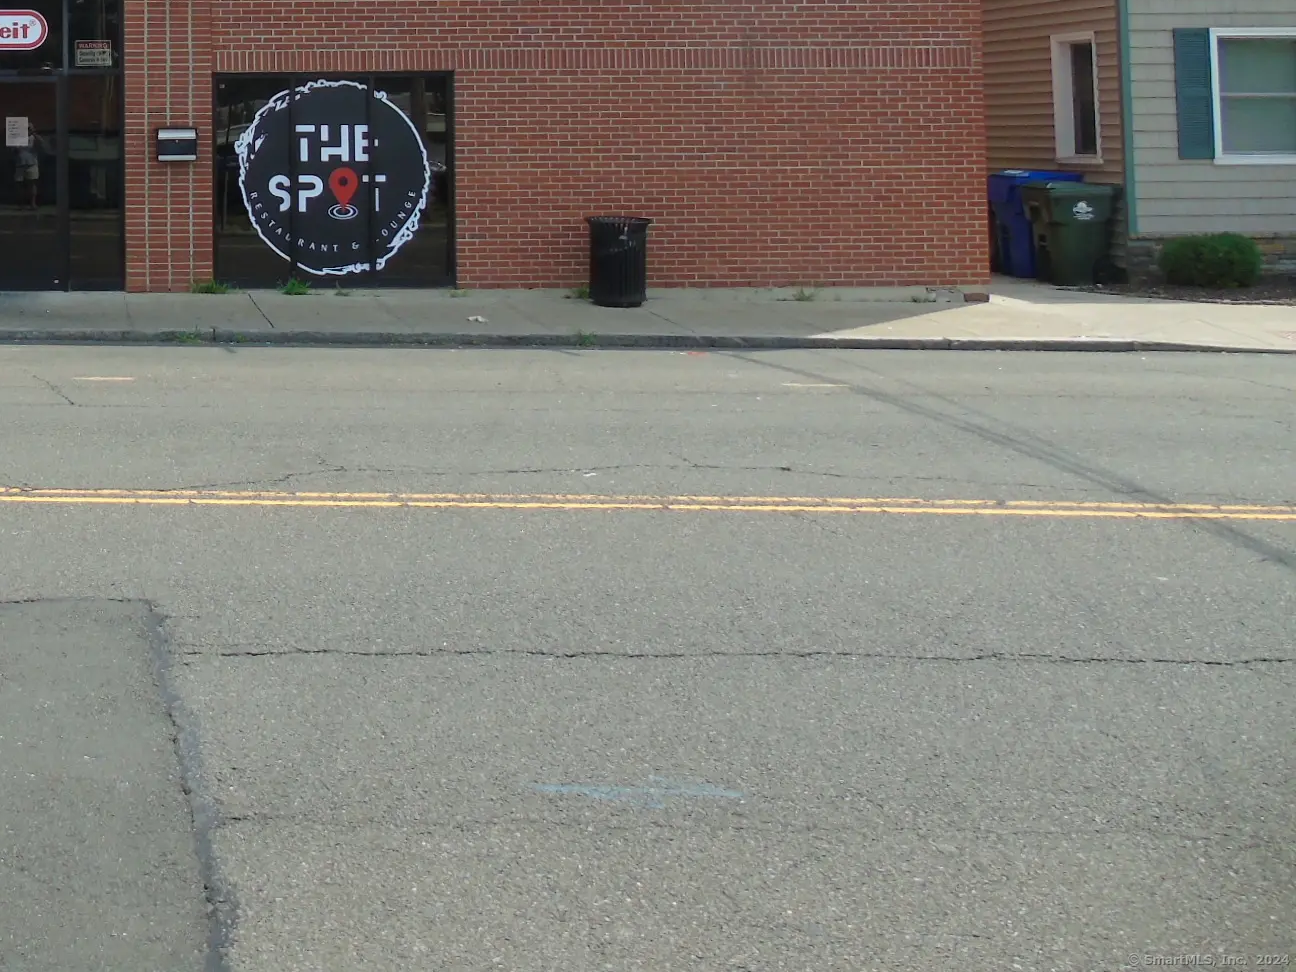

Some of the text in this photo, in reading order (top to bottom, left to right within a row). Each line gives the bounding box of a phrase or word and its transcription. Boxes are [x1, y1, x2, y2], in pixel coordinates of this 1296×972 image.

[295, 124, 379, 162] THE
[351, 241, 360, 250] &
[375, 190, 416, 243] OUNGE
